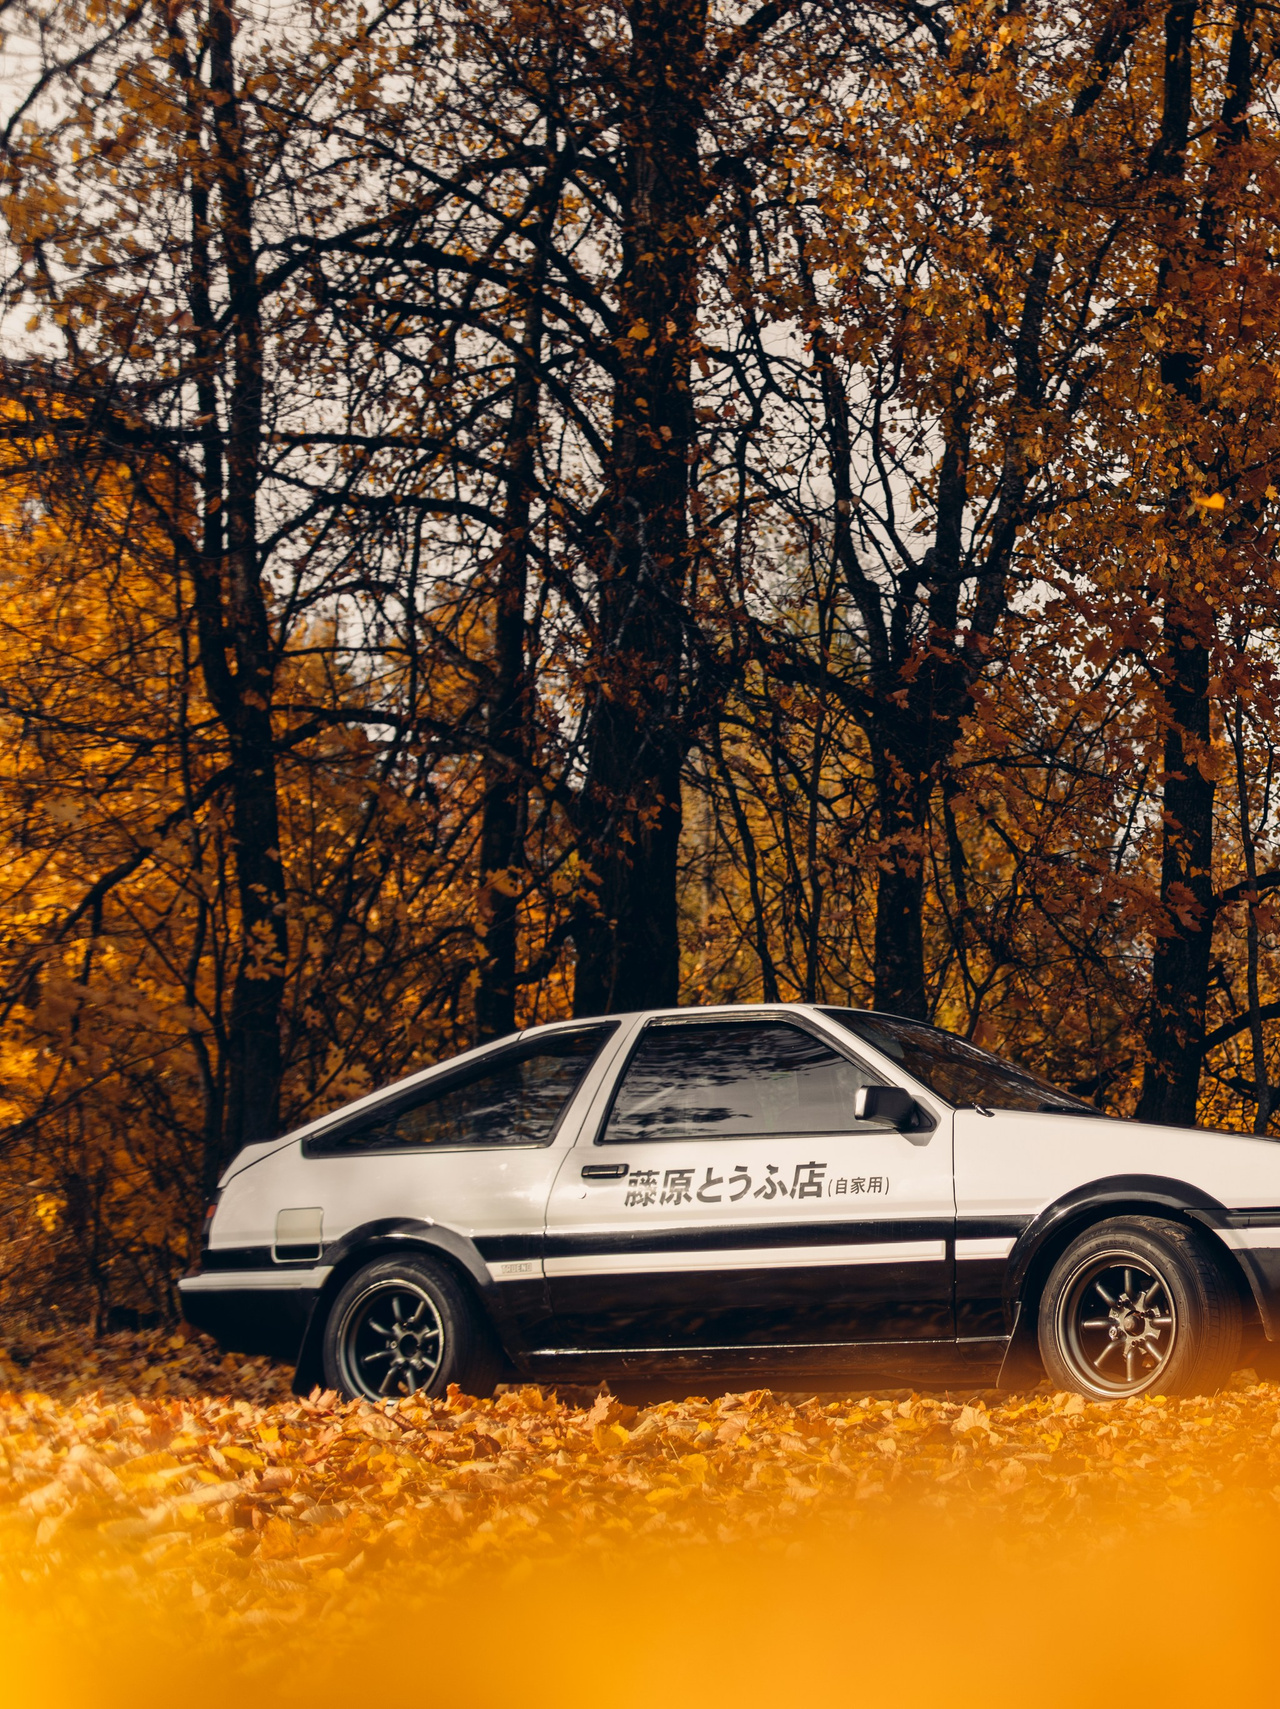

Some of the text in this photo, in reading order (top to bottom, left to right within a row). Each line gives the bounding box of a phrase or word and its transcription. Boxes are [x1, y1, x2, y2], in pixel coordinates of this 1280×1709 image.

[624, 1161, 827, 1207] 藤原とうふ店
